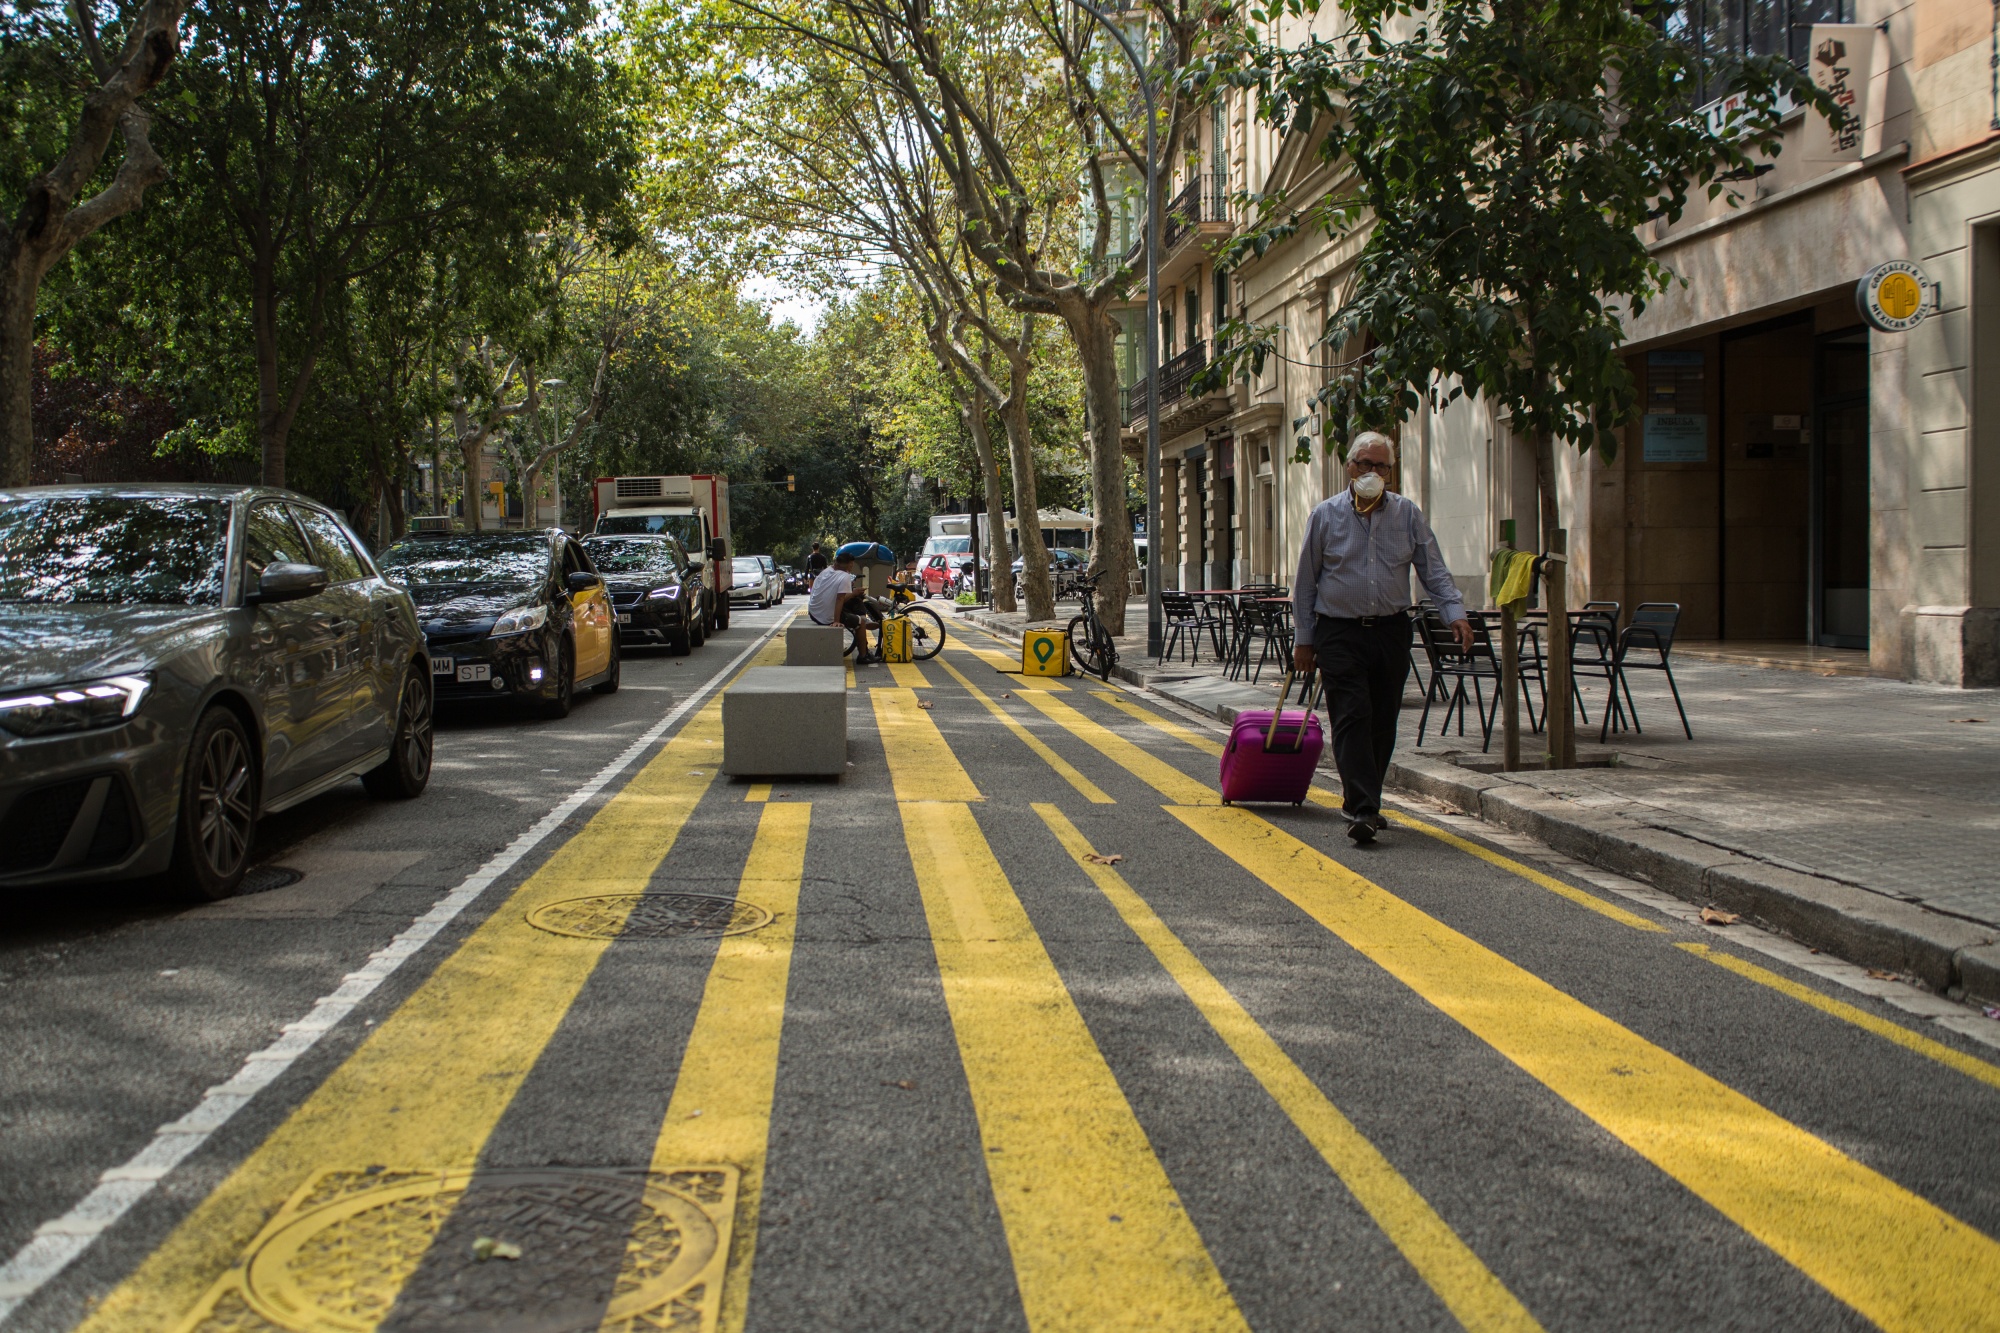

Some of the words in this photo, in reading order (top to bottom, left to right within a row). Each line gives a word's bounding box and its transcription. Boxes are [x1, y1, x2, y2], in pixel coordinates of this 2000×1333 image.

[1871, 263, 1911, 289] GONZALEZ
[1918, 276, 1928, 289] CO
[1871, 303, 1906, 328] MEXICAN
[1909, 303, 1928, 325] GRILL
[420, 520, 437, 529] TAXI
[886, 623, 896, 654] Glovo
